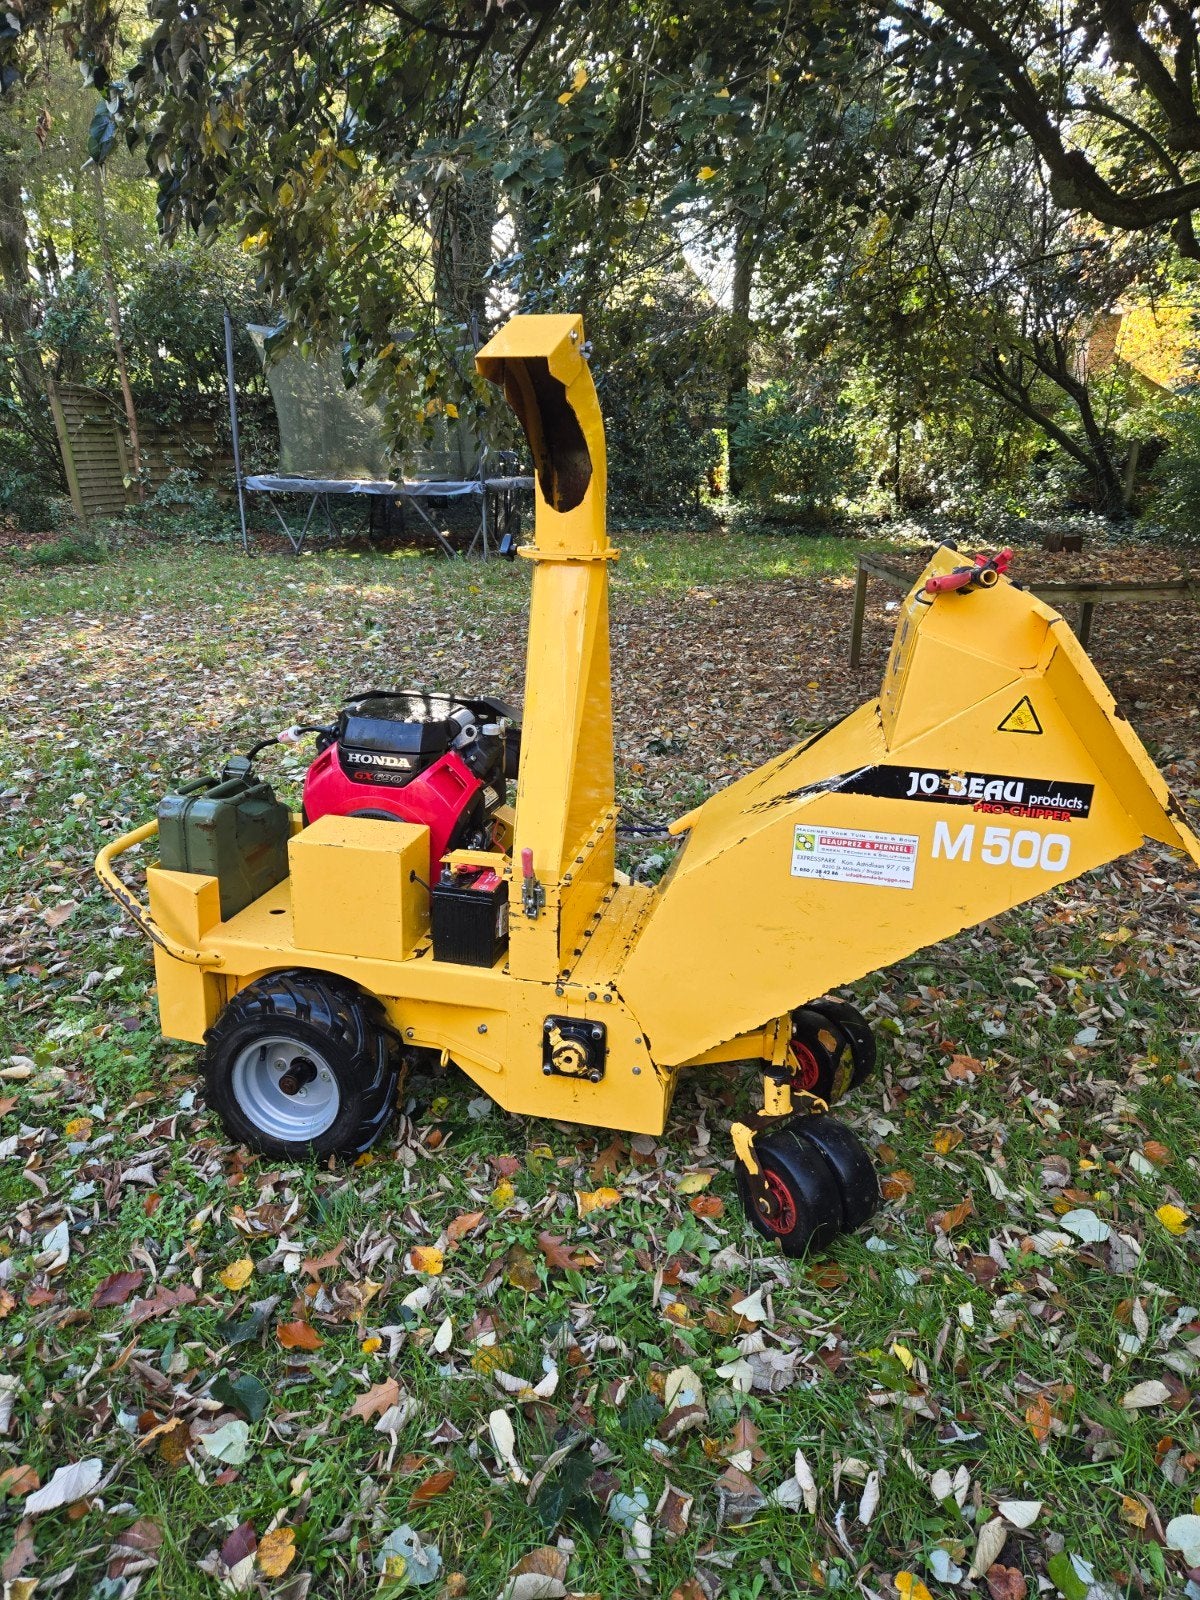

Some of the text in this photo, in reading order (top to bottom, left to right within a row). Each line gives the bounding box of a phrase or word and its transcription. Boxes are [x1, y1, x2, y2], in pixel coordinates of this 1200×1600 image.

[346, 753, 412, 768] HONDA
[906, 771, 1083, 809] JO BEAU products
[973, 803, 1072, 822] PRO-CHIPPER
[821, 837, 862, 848] BEAUPREZ
[874, 843, 907, 852] PERNEEL
[931, 820, 1071, 872] M 500
[796, 854, 836, 864] EXPRESSPARK
